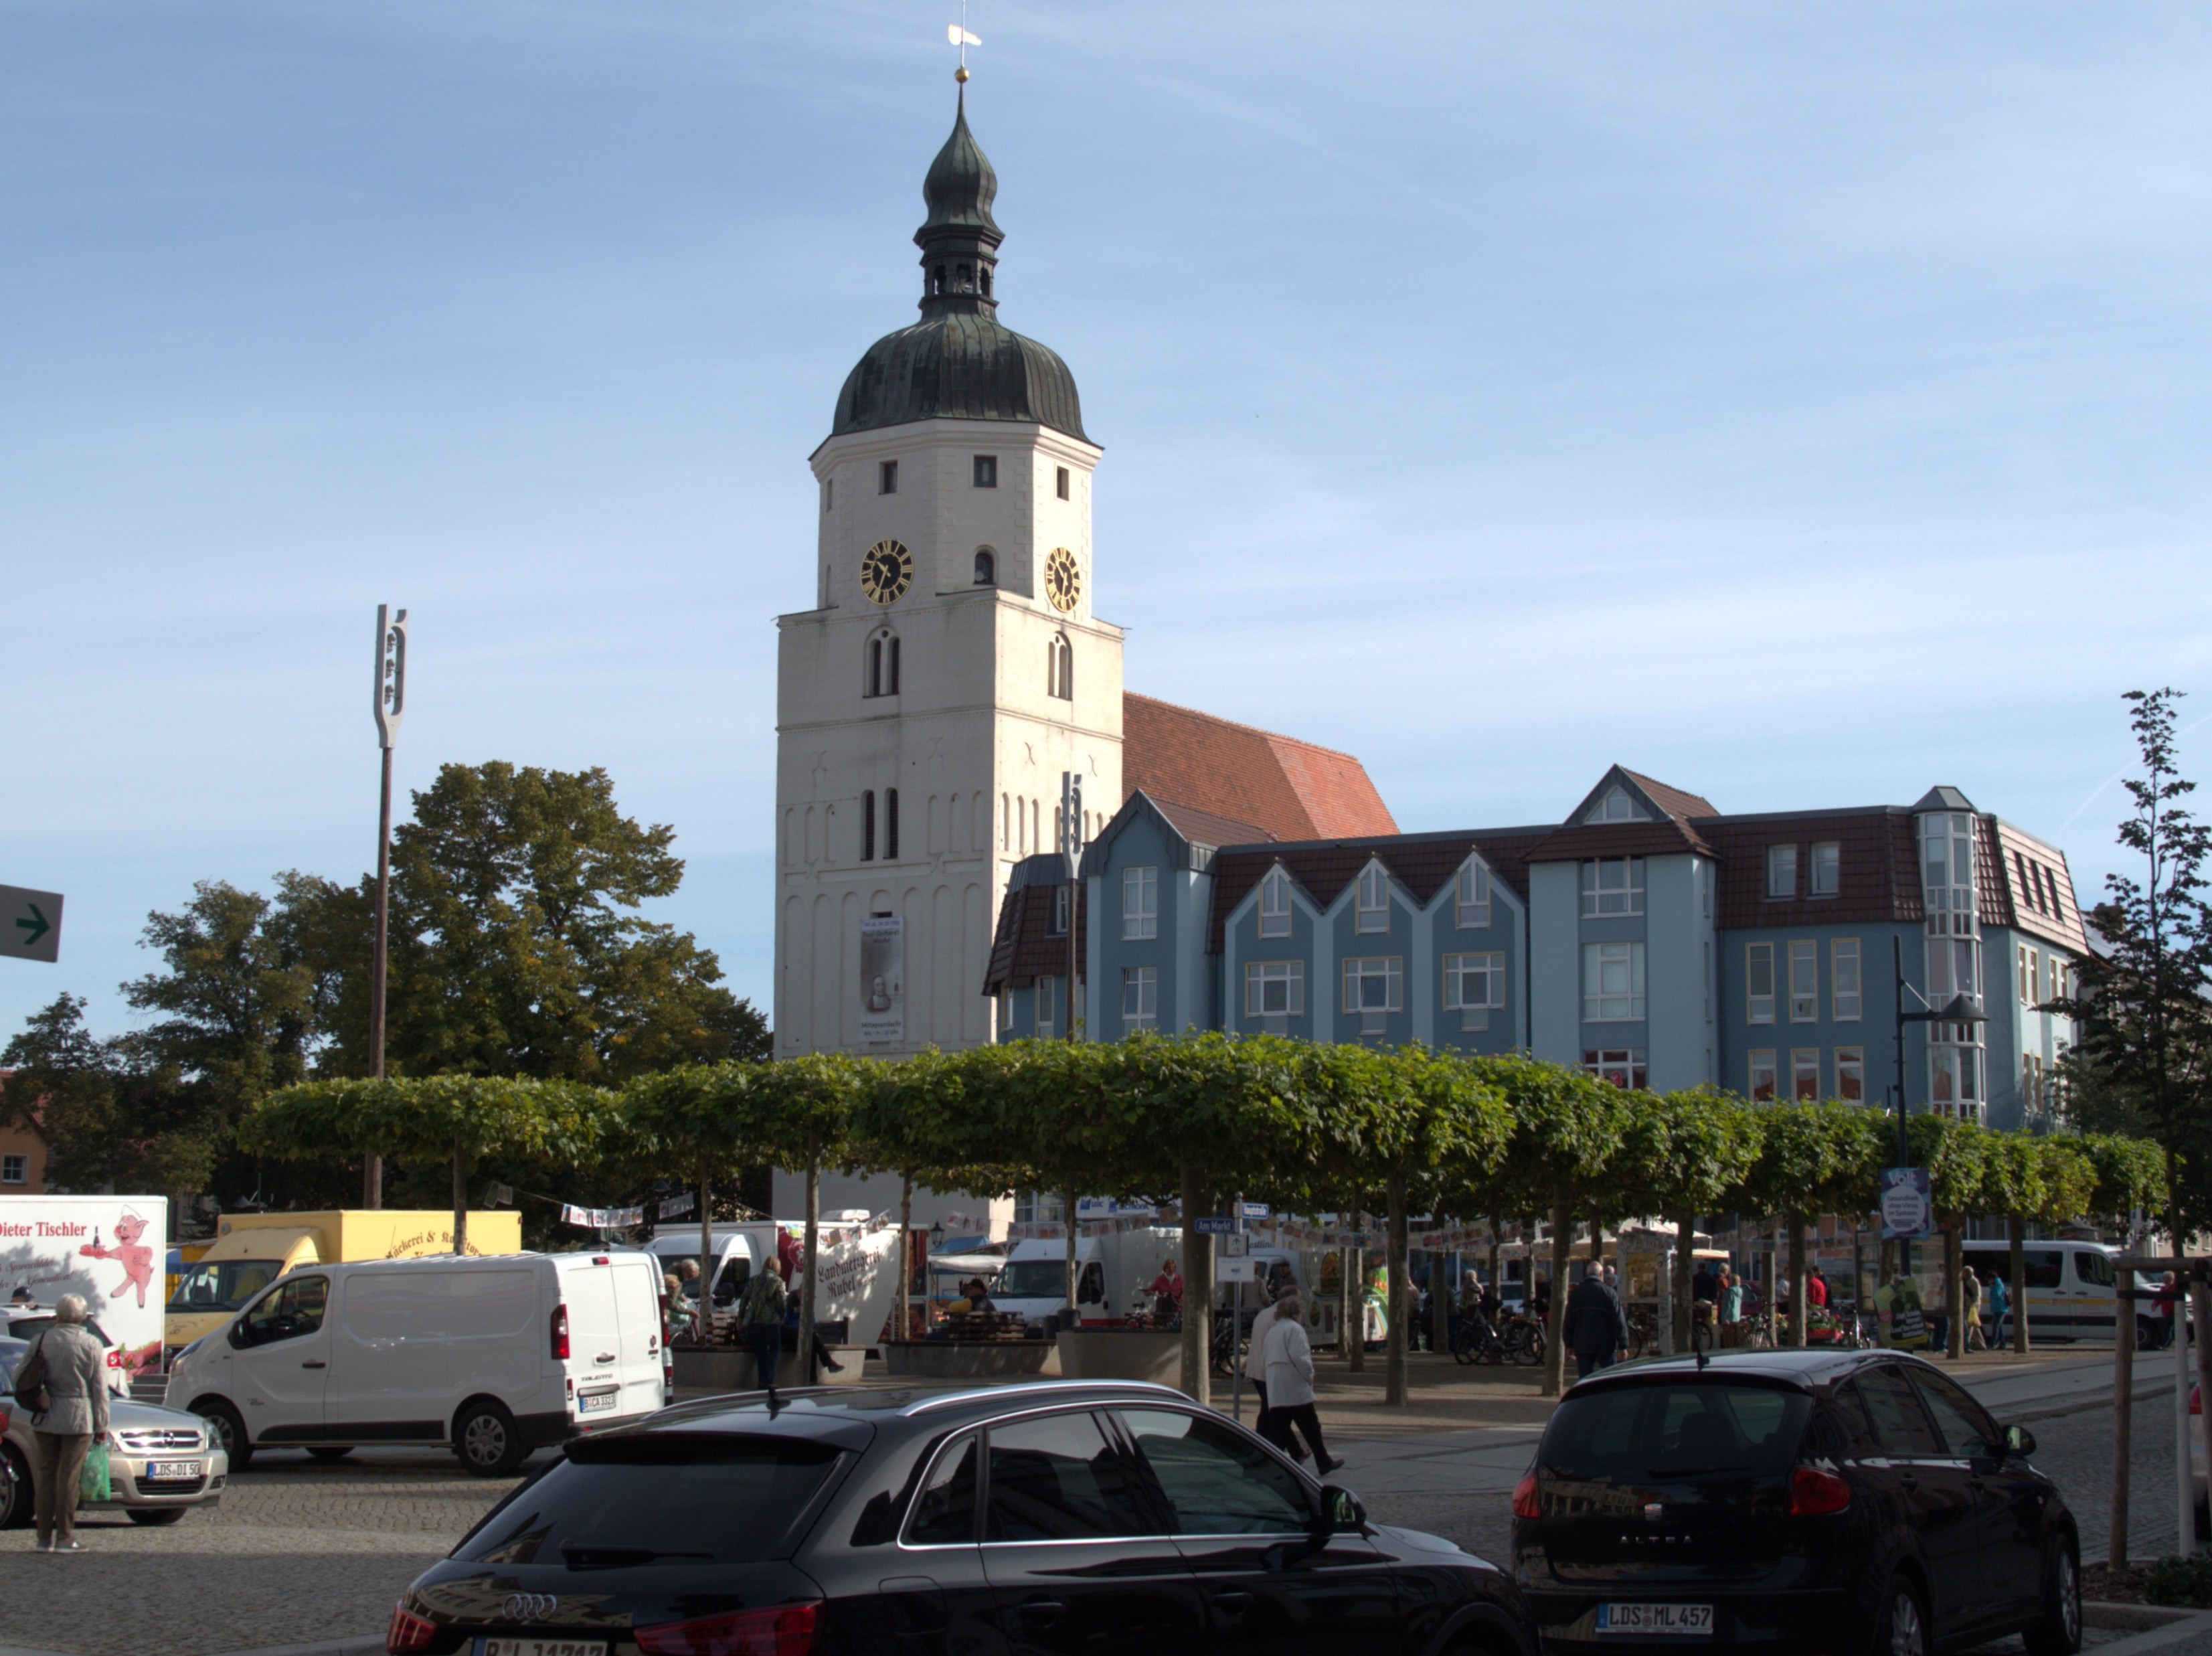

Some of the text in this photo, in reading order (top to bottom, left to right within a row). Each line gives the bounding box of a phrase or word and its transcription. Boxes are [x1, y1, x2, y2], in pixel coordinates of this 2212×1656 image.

[1888, 1171, 1918, 1185] Volt
[35, 1222, 87, 1237] Tischler
[1199, 1220, 1231, 1231] Am Markt
[154, 1464, 172, 1476] LDS
[1620, 1536, 1693, 1544] ALTEA
[1609, 1606, 1711, 1627] LDS ML 457
